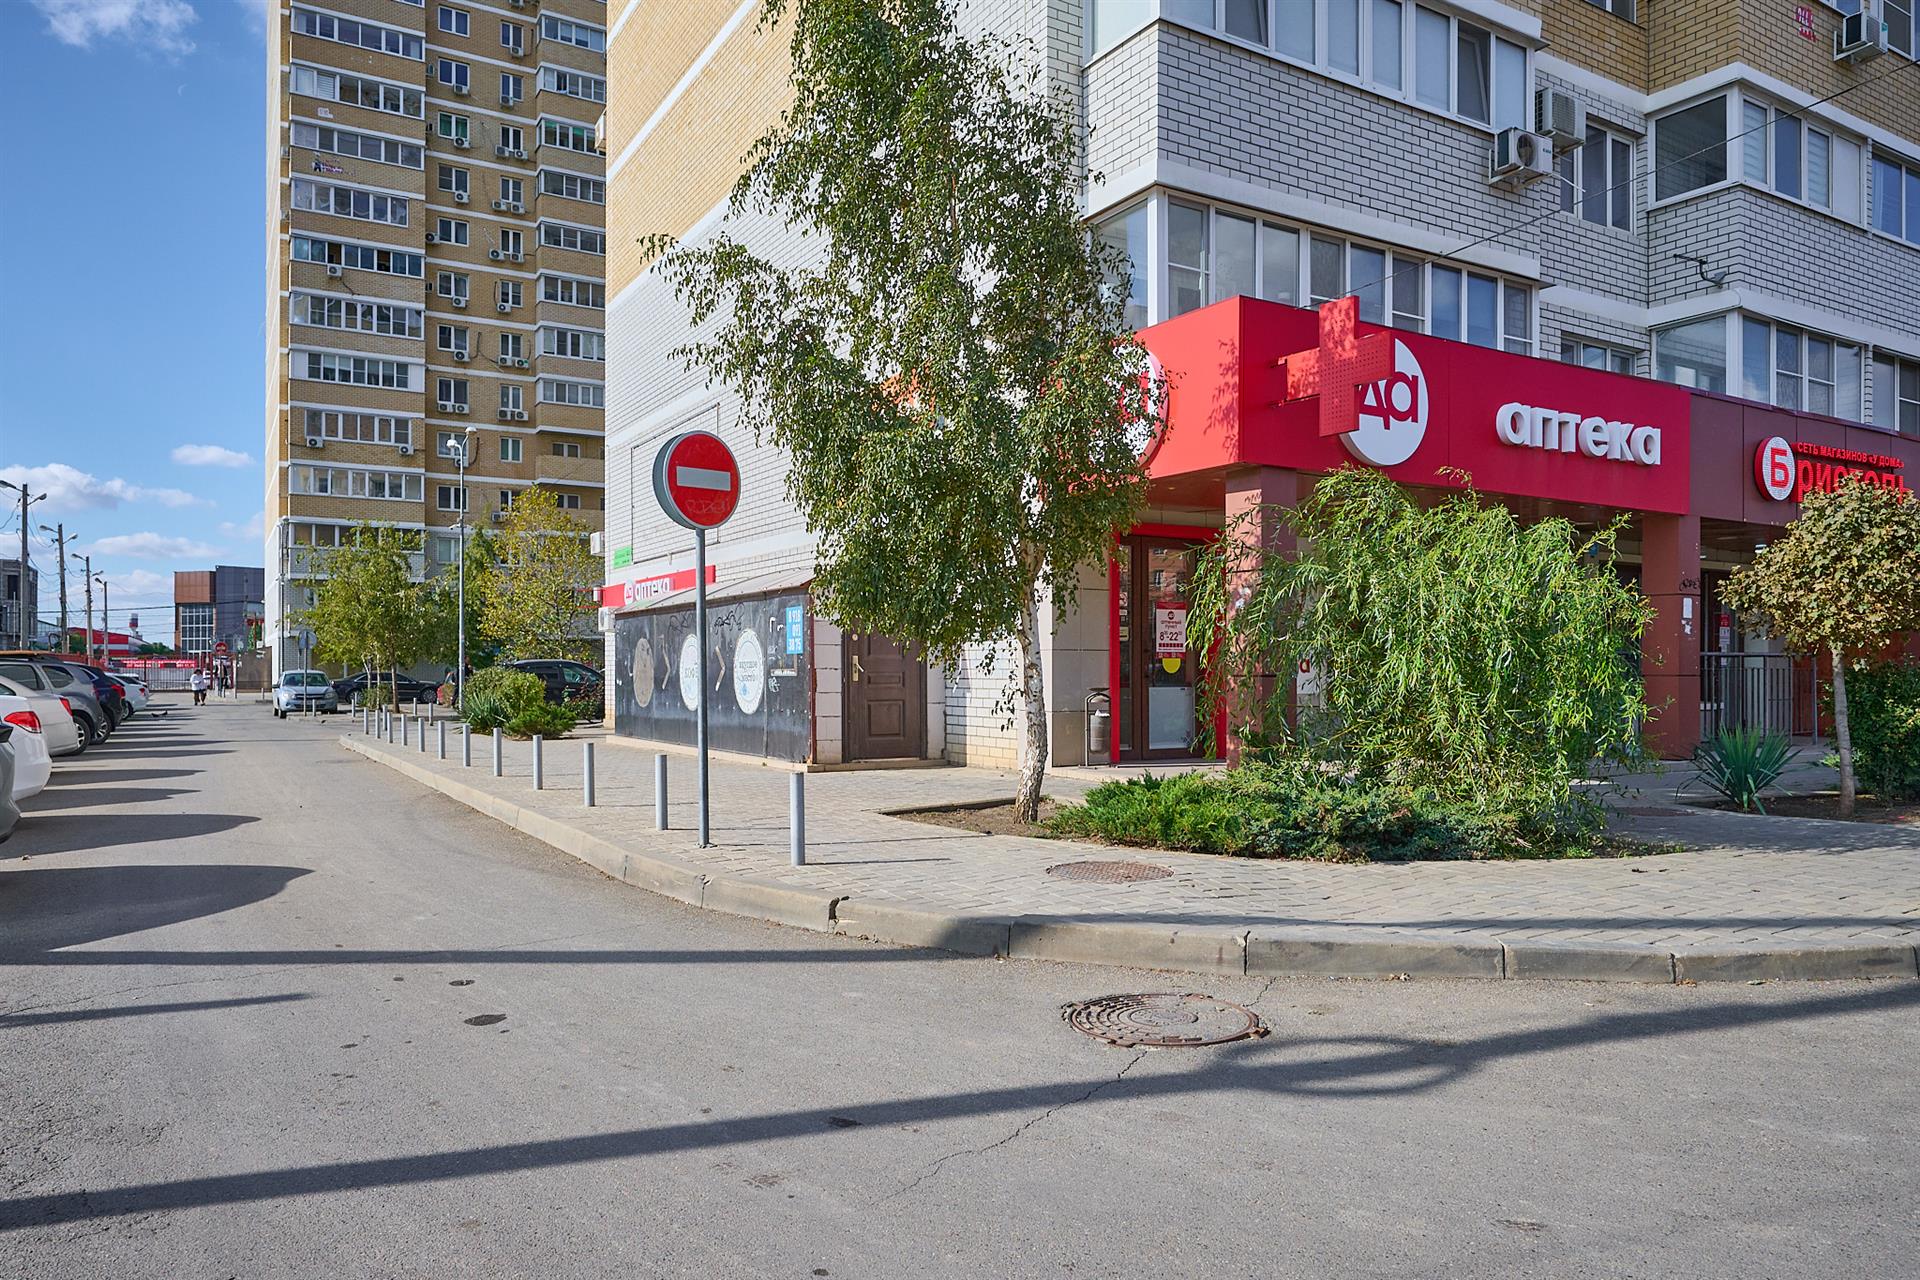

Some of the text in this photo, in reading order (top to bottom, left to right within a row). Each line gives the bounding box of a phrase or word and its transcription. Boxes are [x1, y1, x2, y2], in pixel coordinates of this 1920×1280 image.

[1496, 402, 1661, 466] аптека
[1798, 442, 1905, 469] СЕТЬ МАГАЗИНОВ «У ДОМА»
[635, 577, 671, 601] аптека
